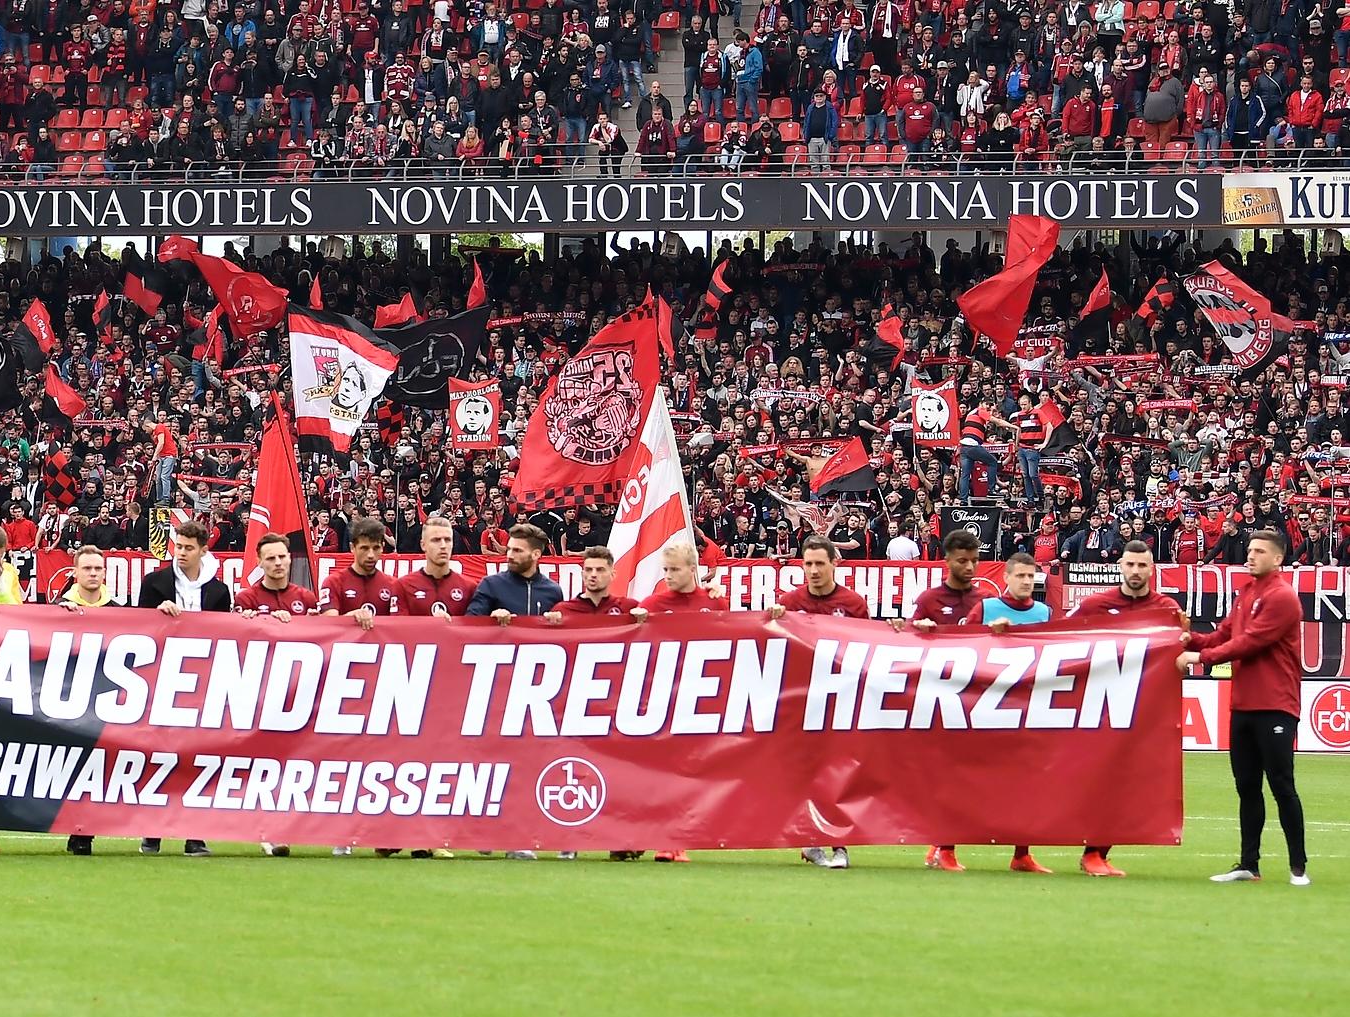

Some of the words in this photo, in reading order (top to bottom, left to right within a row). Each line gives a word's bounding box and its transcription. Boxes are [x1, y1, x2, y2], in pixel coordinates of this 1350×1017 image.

[140, 187, 312, 228] HOTELS
[366, 185, 552, 226] NOVINA
[562, 182, 745, 224] HOTELS
[801, 181, 996, 222] NOVINA
[1012, 178, 1199, 221] HOTELS
[1223, 203, 1278, 223] KULMBACHER
[1027, 337, 1052, 348] Club
[456, 434, 492, 442] STADION
[915, 431, 951, 440] STADION
[460, 638, 788, 736] TREUEN
[803, 637, 1150, 731] HERZEN
[182, 754, 511, 817] ZERREISSEN!
[543, 784, 598, 811] FCN
